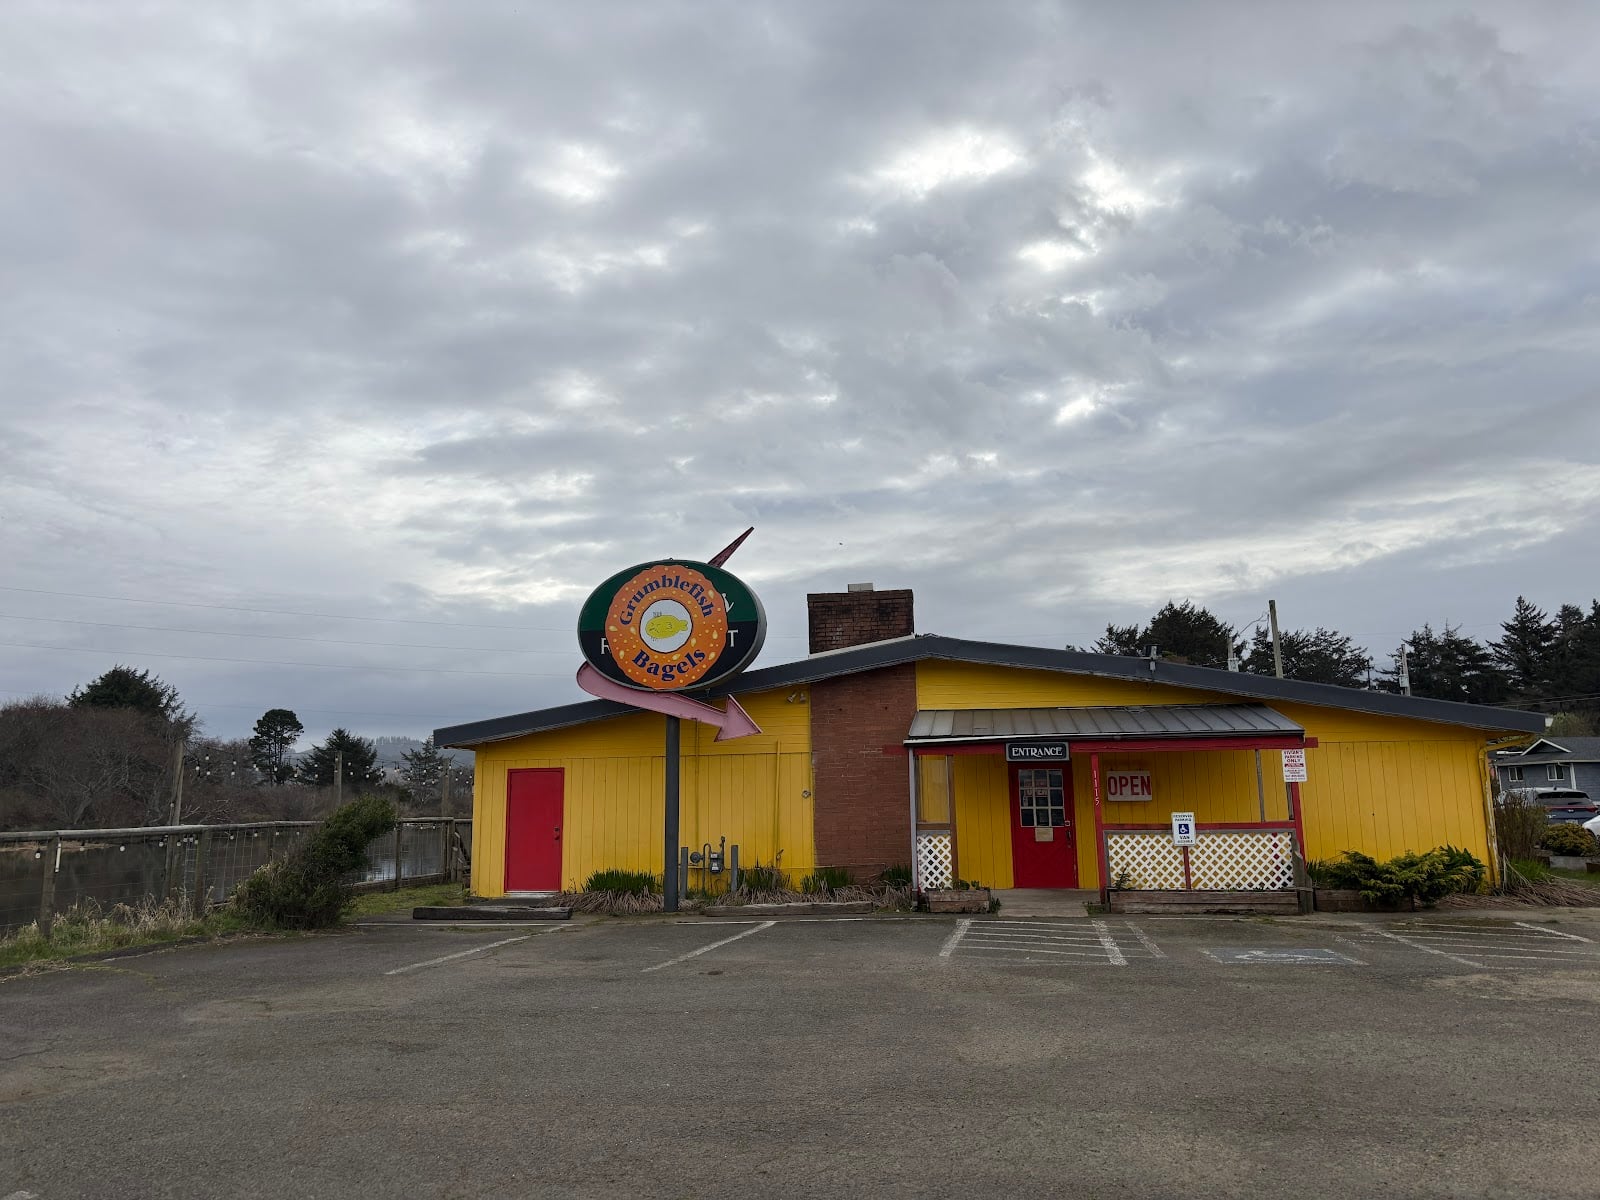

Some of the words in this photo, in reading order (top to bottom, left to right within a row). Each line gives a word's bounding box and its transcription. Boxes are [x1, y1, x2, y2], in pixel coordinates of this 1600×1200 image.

[619, 574, 715, 626] Grumblefish
[632, 648, 706, 682] Bagels
[1012, 746, 1063, 758] ENTRANCE
[1108, 775, 1151, 796] OPEN
